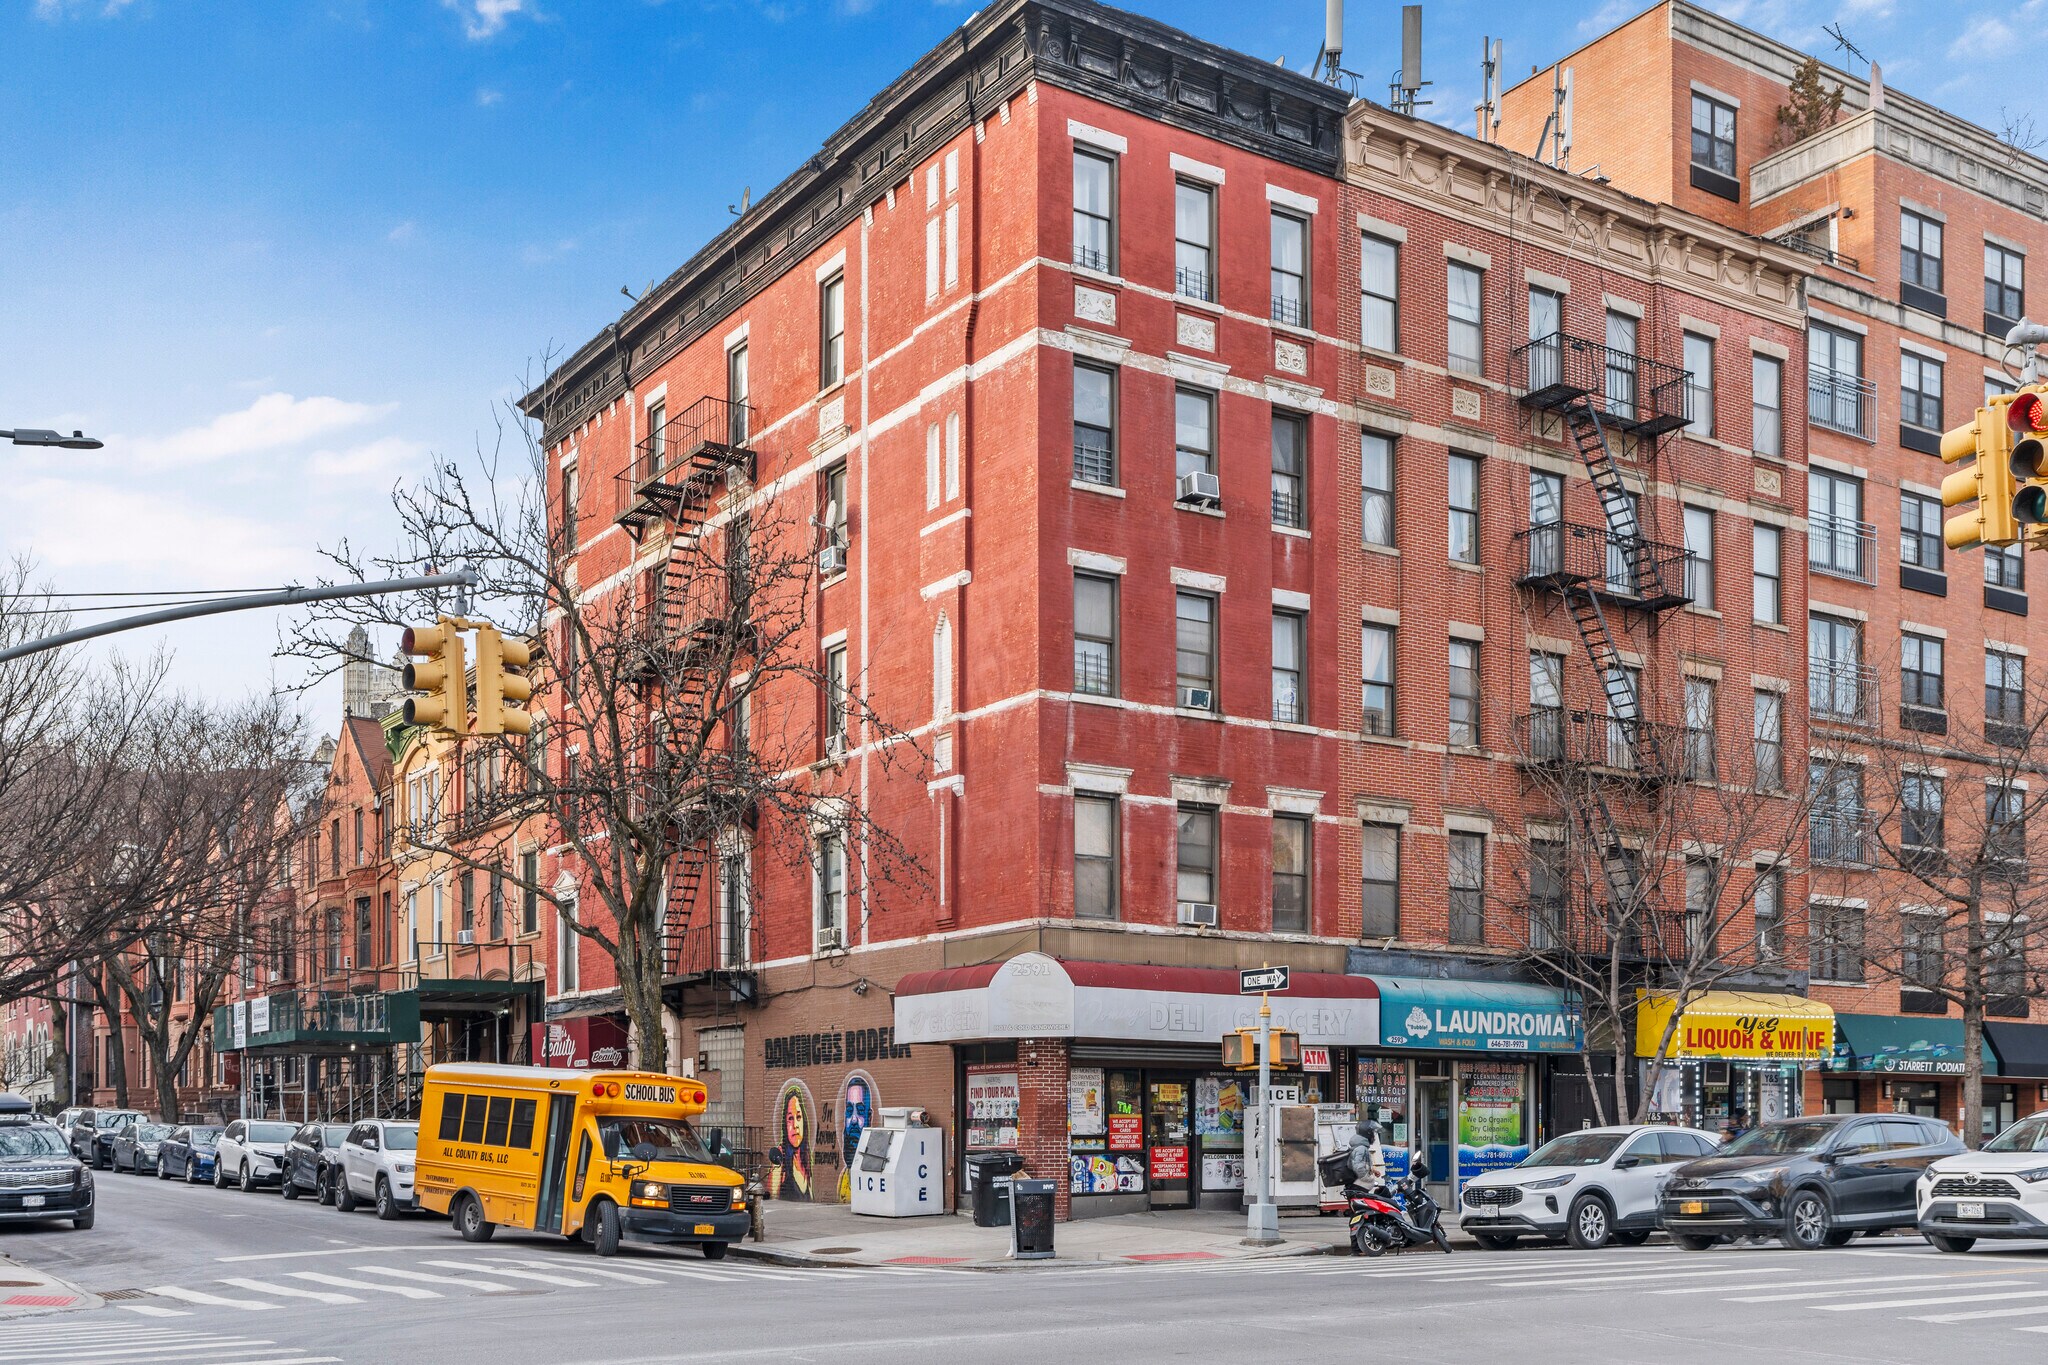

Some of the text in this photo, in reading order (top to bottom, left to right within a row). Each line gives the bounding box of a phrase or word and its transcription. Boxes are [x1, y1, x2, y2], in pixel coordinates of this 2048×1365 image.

[1012, 962, 1050, 976] 2591
[1247, 974, 1281, 986] ONE WAY
[929, 1011, 982, 1033] GROCERY
[1150, 1002, 1204, 1032] DELI
[1436, 1009, 1579, 1037] LAUNDROMAT
[1031, 1023, 1070, 1031] SANDWICHES
[1391, 1036, 1404, 1044] 2593
[1439, 1038, 1454, 1046] WASH
[1461, 1039, 1476, 1047] FOLD
[1491, 1040, 1525, 1048] 646-781-9973
[1687, 1028, 1754, 1050] LIQUOR
[1760, 1030, 1773, 1049] &
[1304, 1050, 1328, 1065] ATM
[1358, 1061, 1404, 1074] OPEN FROM
[1898, 1060, 1933, 1072] STARRETT
[1362, 1074, 1407, 1086] AM 12 AM
[1764, 1074, 1779, 1082] Y&S
[625, 1084, 675, 1103] SCHOOL BUS
[970, 1086, 1016, 1099] FIND YOUR PACK.
[1387, 1086, 1407, 1095] FOLD
[1469, 1086, 1520, 1097] 646-781-9973
[1489, 1116, 1513, 1124] Organic
[1647, 1112, 1661, 1121] Y&S
[1468, 1135, 1493, 1143] Laundry
[443, 1147, 509, 1164] ALL COUNTY BUS, LLC
[1474, 1151, 1513, 1159] 646-781-9973
[918, 1141, 928, 1201] ICE
[858, 1176, 886, 1193] ICE
[690, 1195, 713, 1203] GMC
